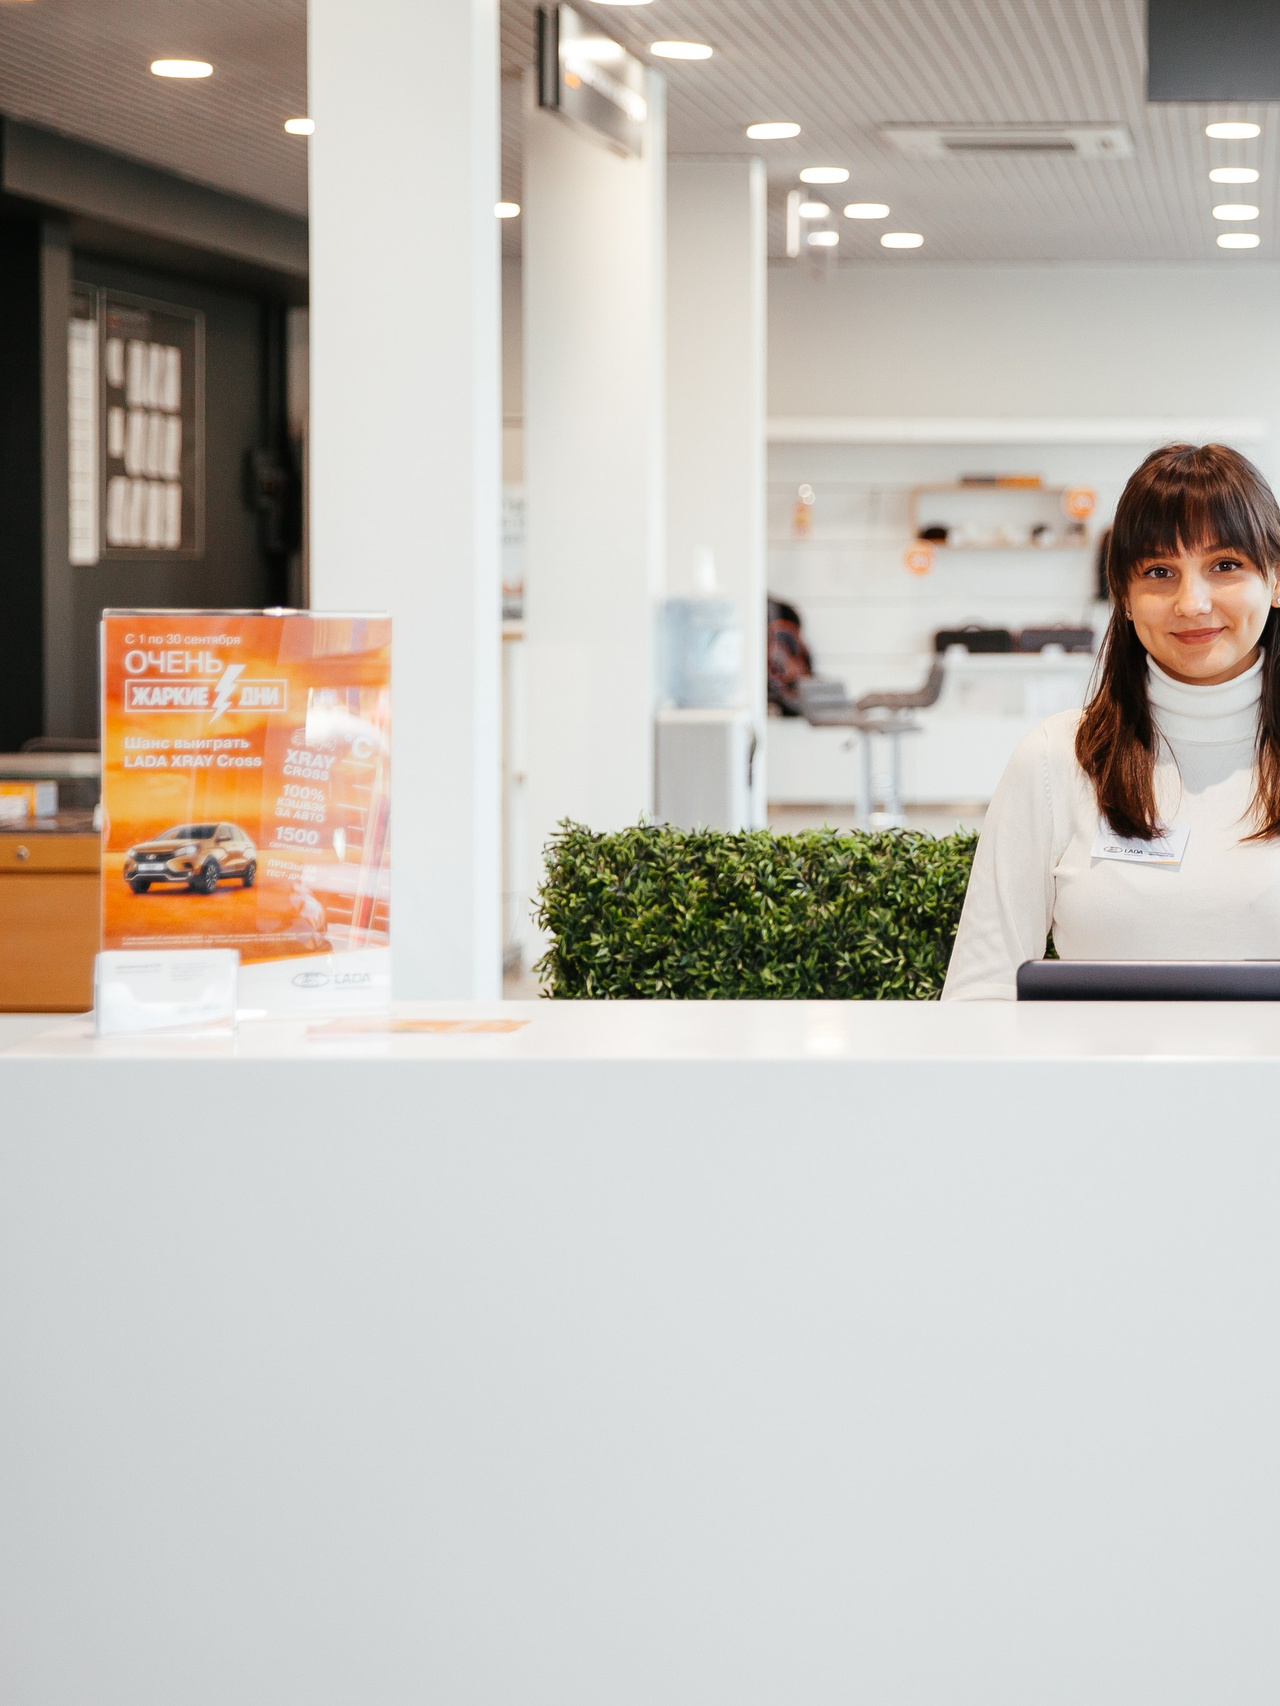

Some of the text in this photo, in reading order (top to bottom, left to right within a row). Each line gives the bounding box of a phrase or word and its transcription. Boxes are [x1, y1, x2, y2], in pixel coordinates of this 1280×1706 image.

[124, 633, 242, 646] С 1 по 30 сентября
[124, 649, 223, 674] ОЧЕНЬ
[131, 685, 279, 706] ЖАРКИЕ ДНИ
[124, 737, 250, 751] Шанс выиграть
[124, 754, 262, 768] LADA XRAY Cross
[284, 748, 336, 770] XRAY
[282, 764, 330, 782] CROSS
[282, 783, 325, 802] 100%
[274, 807, 325, 823] ЗА АВТО
[275, 825, 319, 846] 1500
[334, 973, 372, 984] LADA
